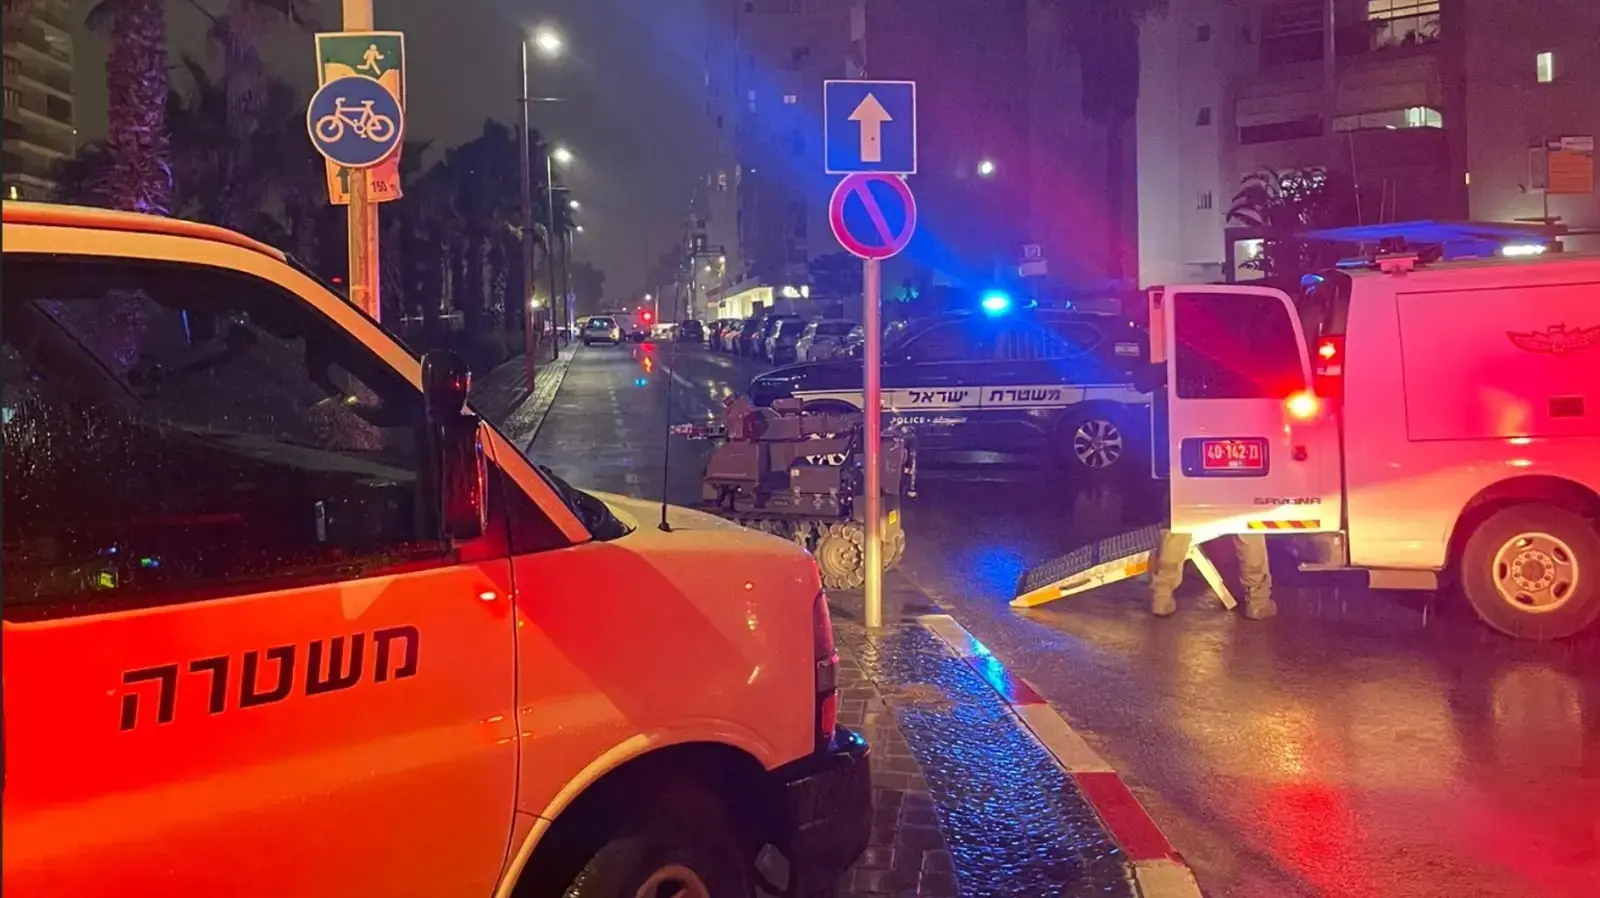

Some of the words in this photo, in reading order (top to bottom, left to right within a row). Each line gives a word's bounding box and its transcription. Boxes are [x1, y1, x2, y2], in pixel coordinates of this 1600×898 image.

[371, 180, 388, 193] 150
[908, 391, 968, 403] ישראל
[988, 389, 1061, 402] משטרת
[891, 416, 925, 426] POLICE
[119, 625, 420, 732] משטרה
